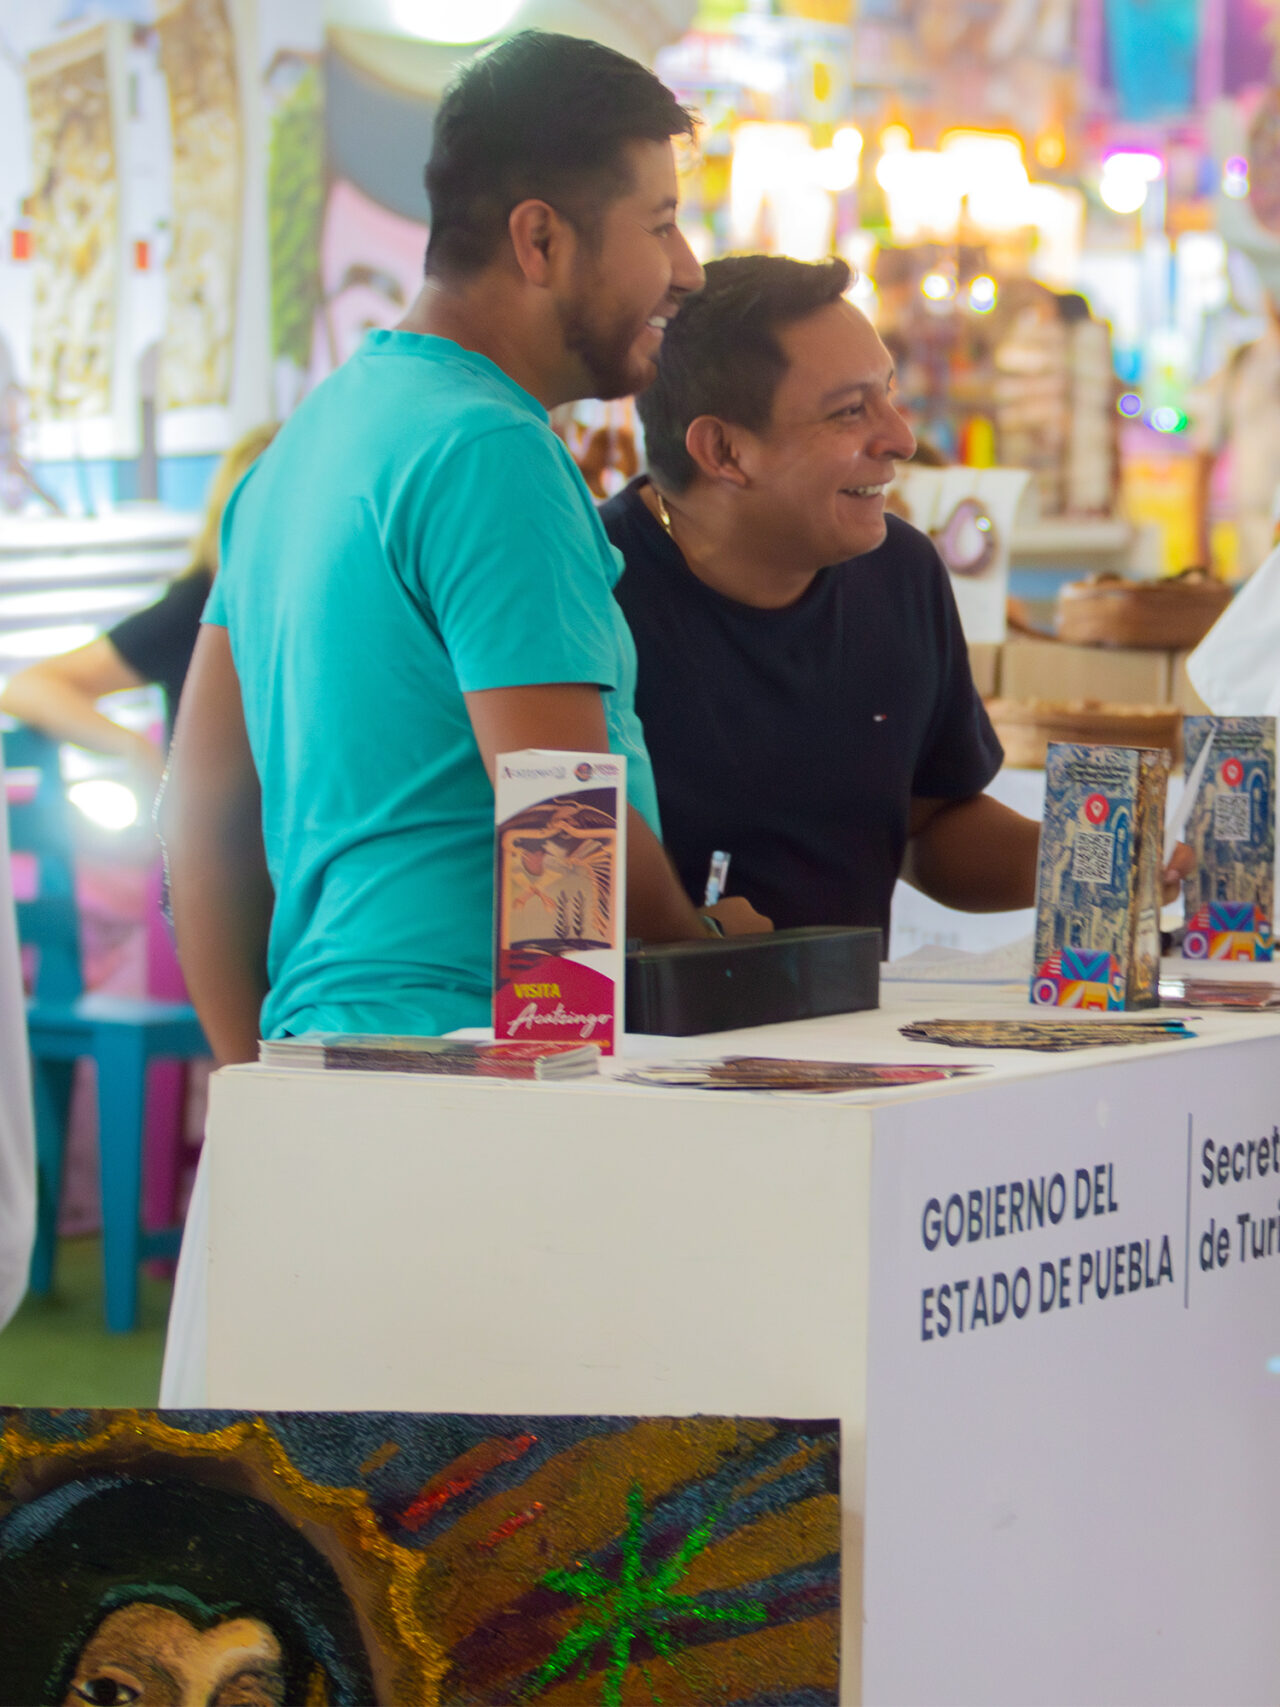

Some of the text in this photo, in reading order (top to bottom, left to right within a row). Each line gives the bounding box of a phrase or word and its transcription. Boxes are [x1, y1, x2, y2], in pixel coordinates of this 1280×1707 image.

[513, 983, 561, 998] VISITA
[506, 1002, 613, 1038] Acatzingo
[921, 1162, 1118, 1251] GOBIERNO DEL
[1199, 1217, 1230, 1271] de
[921, 1235, 1174, 1341] ESTADO DE PUEBLA
